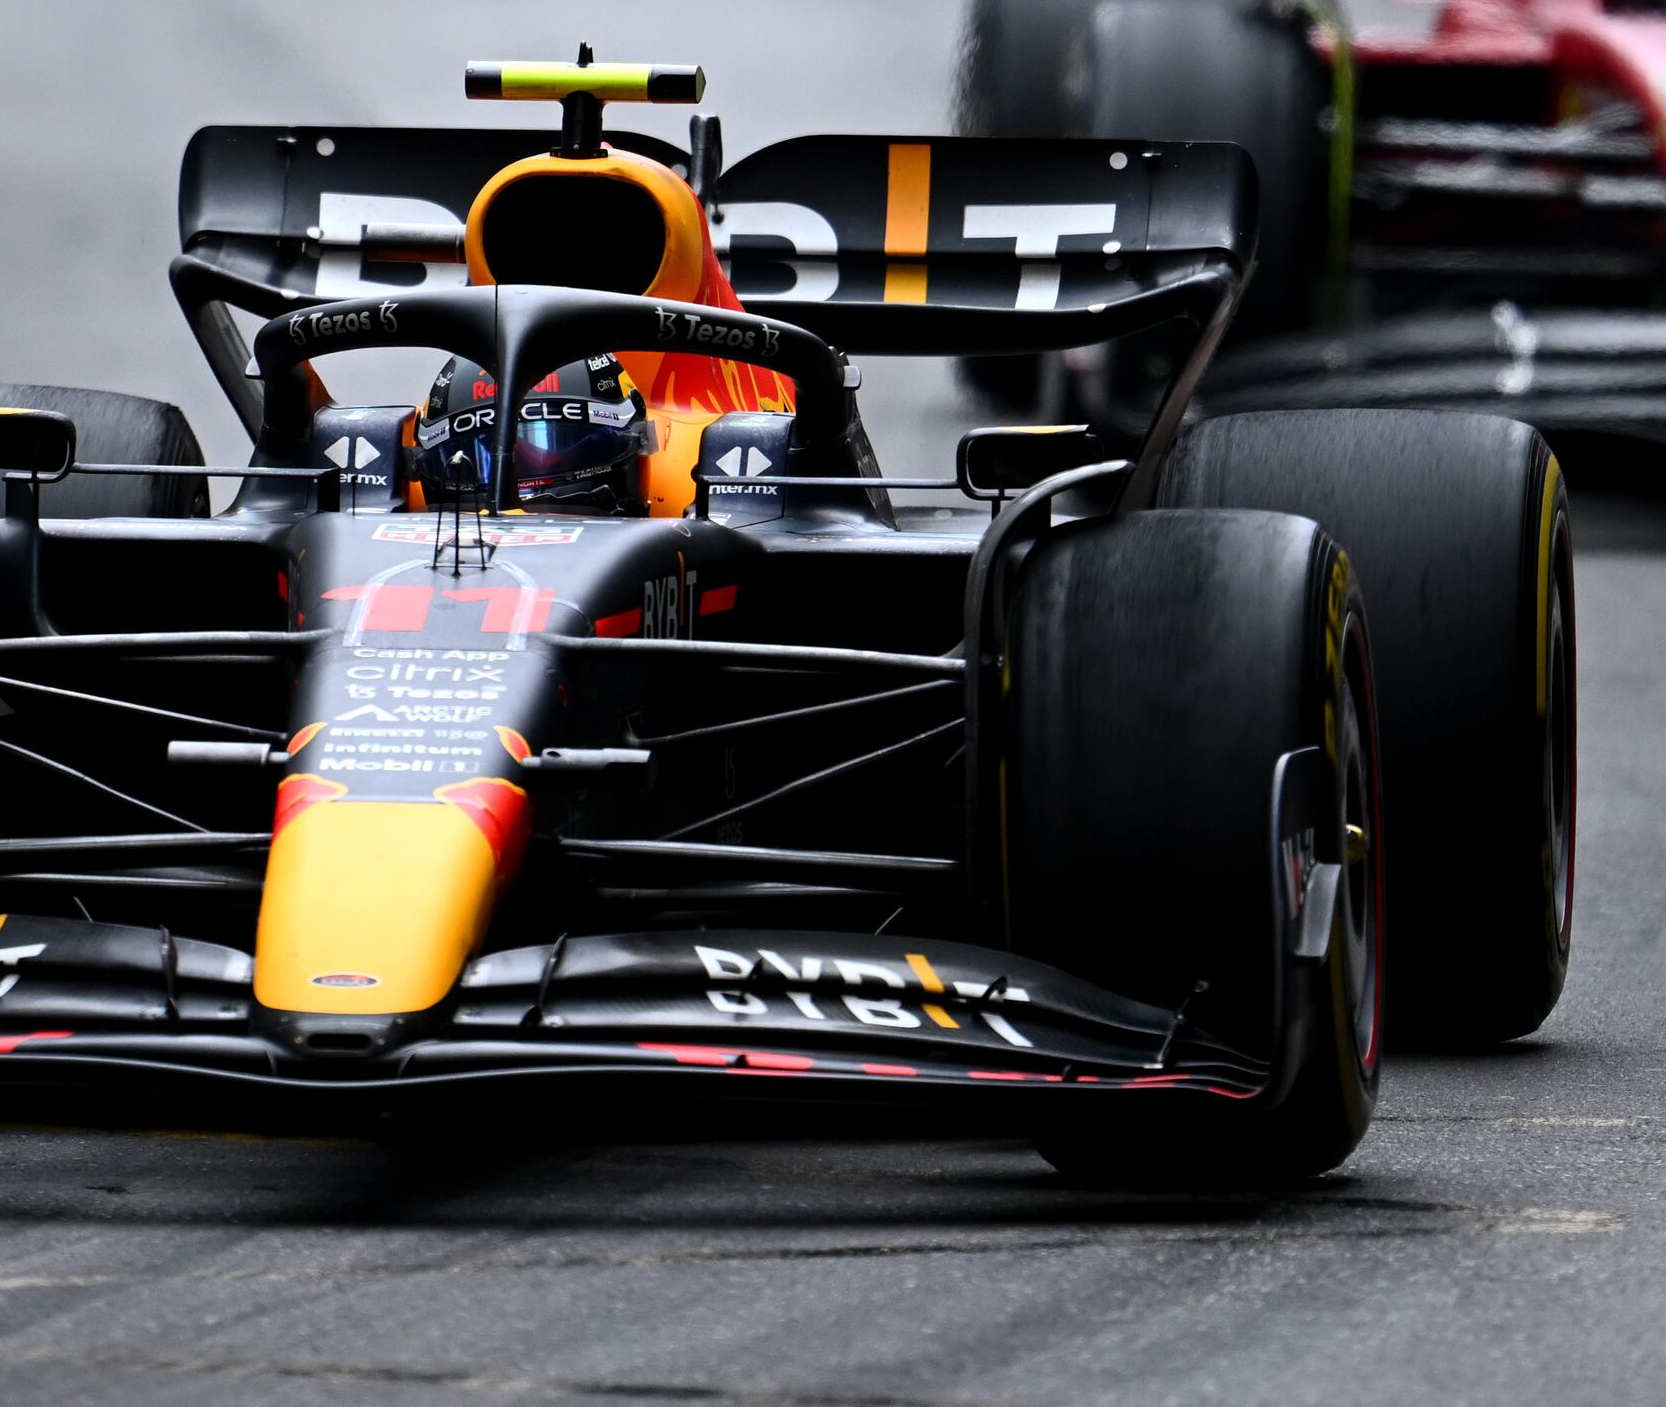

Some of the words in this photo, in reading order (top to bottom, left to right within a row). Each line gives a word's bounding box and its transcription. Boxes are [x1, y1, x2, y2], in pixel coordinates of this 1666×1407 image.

[316, 144, 1117, 311] BBIT
[309, 310, 372, 338] Tezos
[684, 314, 756, 349] Tezos
[472, 381, 498, 401] Re
[532, 373, 559, 393] ull
[453, 402, 583, 433] ORCLE
[321, 585, 556, 633] 11
[353, 648, 433, 659] Cash
[442, 650, 511, 662] App
[387, 685, 508, 700] Tezos
[393, 705, 494, 716] ARCTIC
[404, 713, 483, 723] WOLF
[319, 758, 434, 773] Mobil
